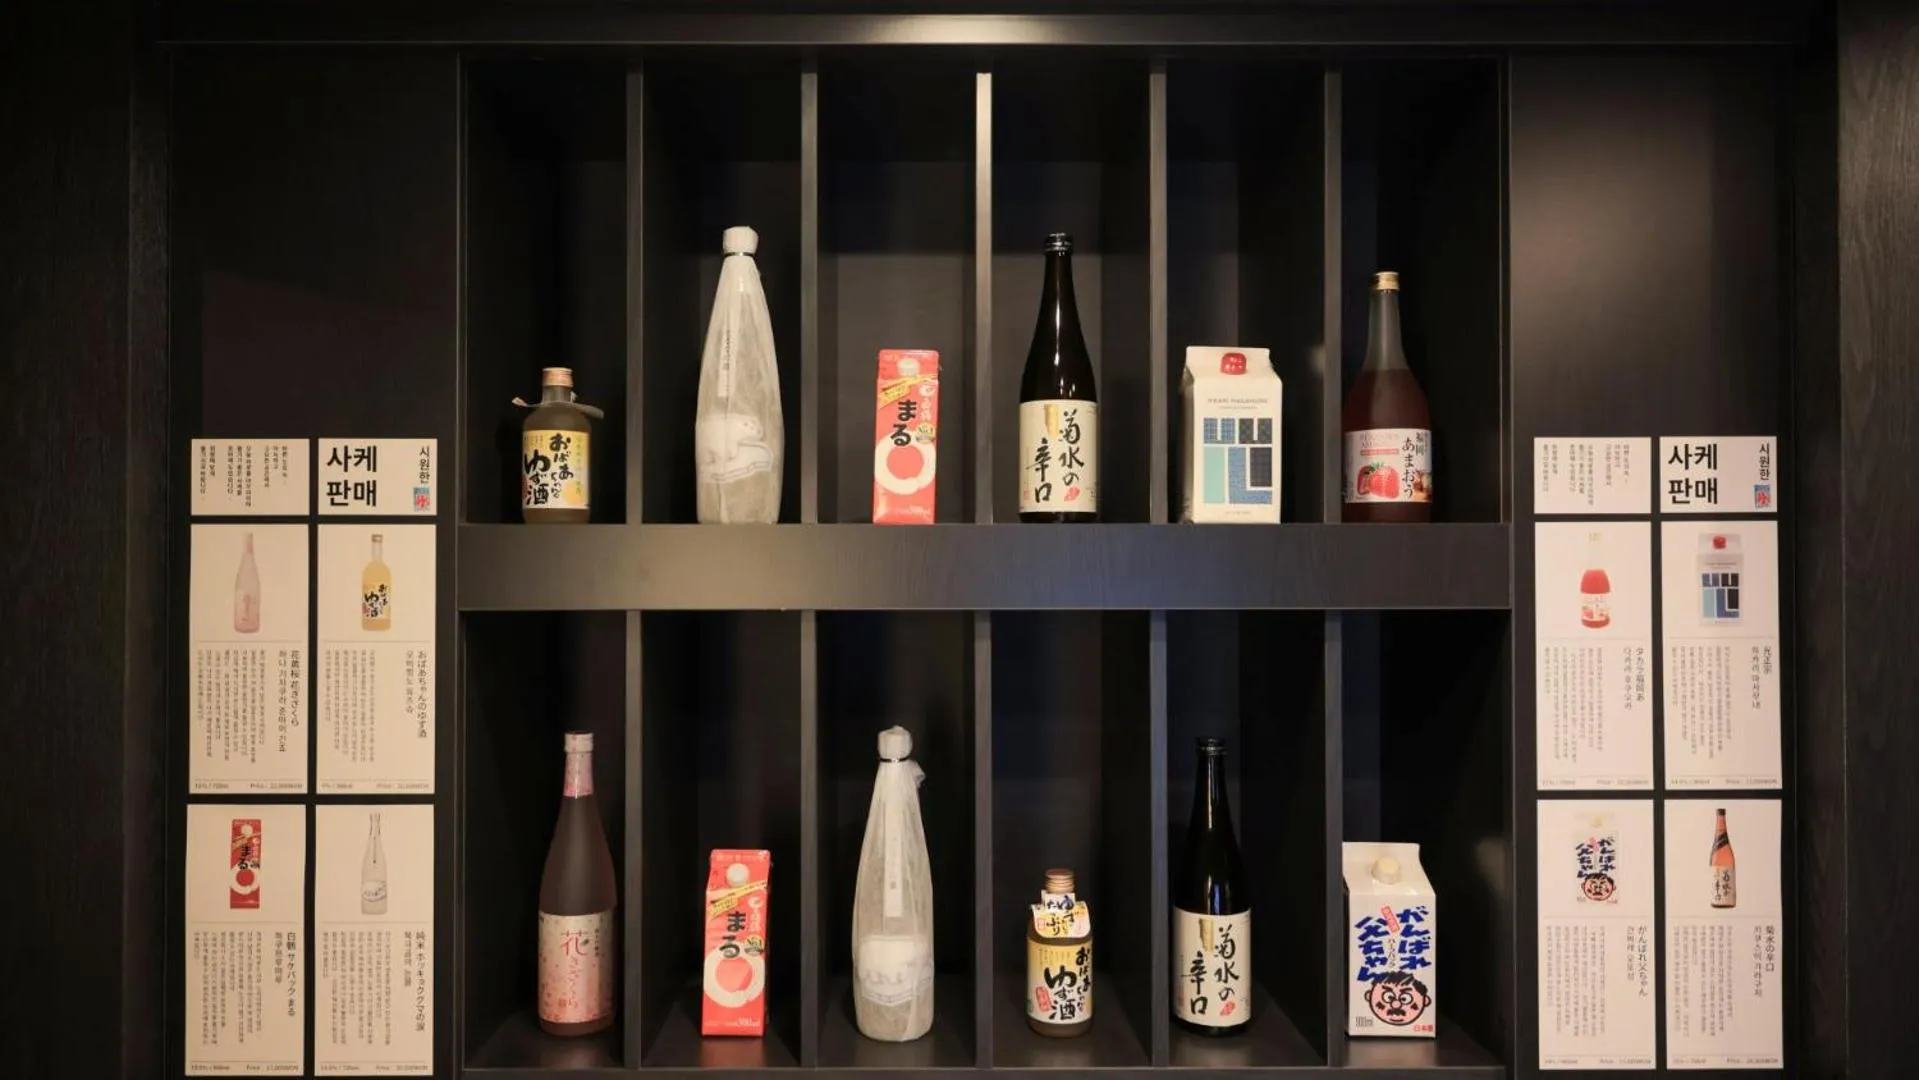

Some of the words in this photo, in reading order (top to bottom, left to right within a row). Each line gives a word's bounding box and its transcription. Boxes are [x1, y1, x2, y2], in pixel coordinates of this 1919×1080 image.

[890, 399, 917, 446] まる
[1058, 408, 1085, 486] 菊水の
[326, 444, 378, 474] 사케
[418, 445, 431, 485] 시원한
[524, 449, 551, 505] ゆず酒
[1034, 436, 1053, 503] 辛口
[1401, 436, 1416, 499] あまおう
[1667, 443, 1718, 472] 사케
[1758, 442, 1771, 481] 시원한
[326, 479, 378, 507] 판매
[1667, 477, 1718, 505] 판매
[719, 911, 746, 958] まる
[1213, 923, 1240, 1001] 菊水の
[1355, 916, 1390, 981] 父ちゃん
[1396, 905, 1432, 971] がんばれ
[1043, 964, 1077, 1021] ゆず酒
[1189, 950, 1209, 1015] 辛口
